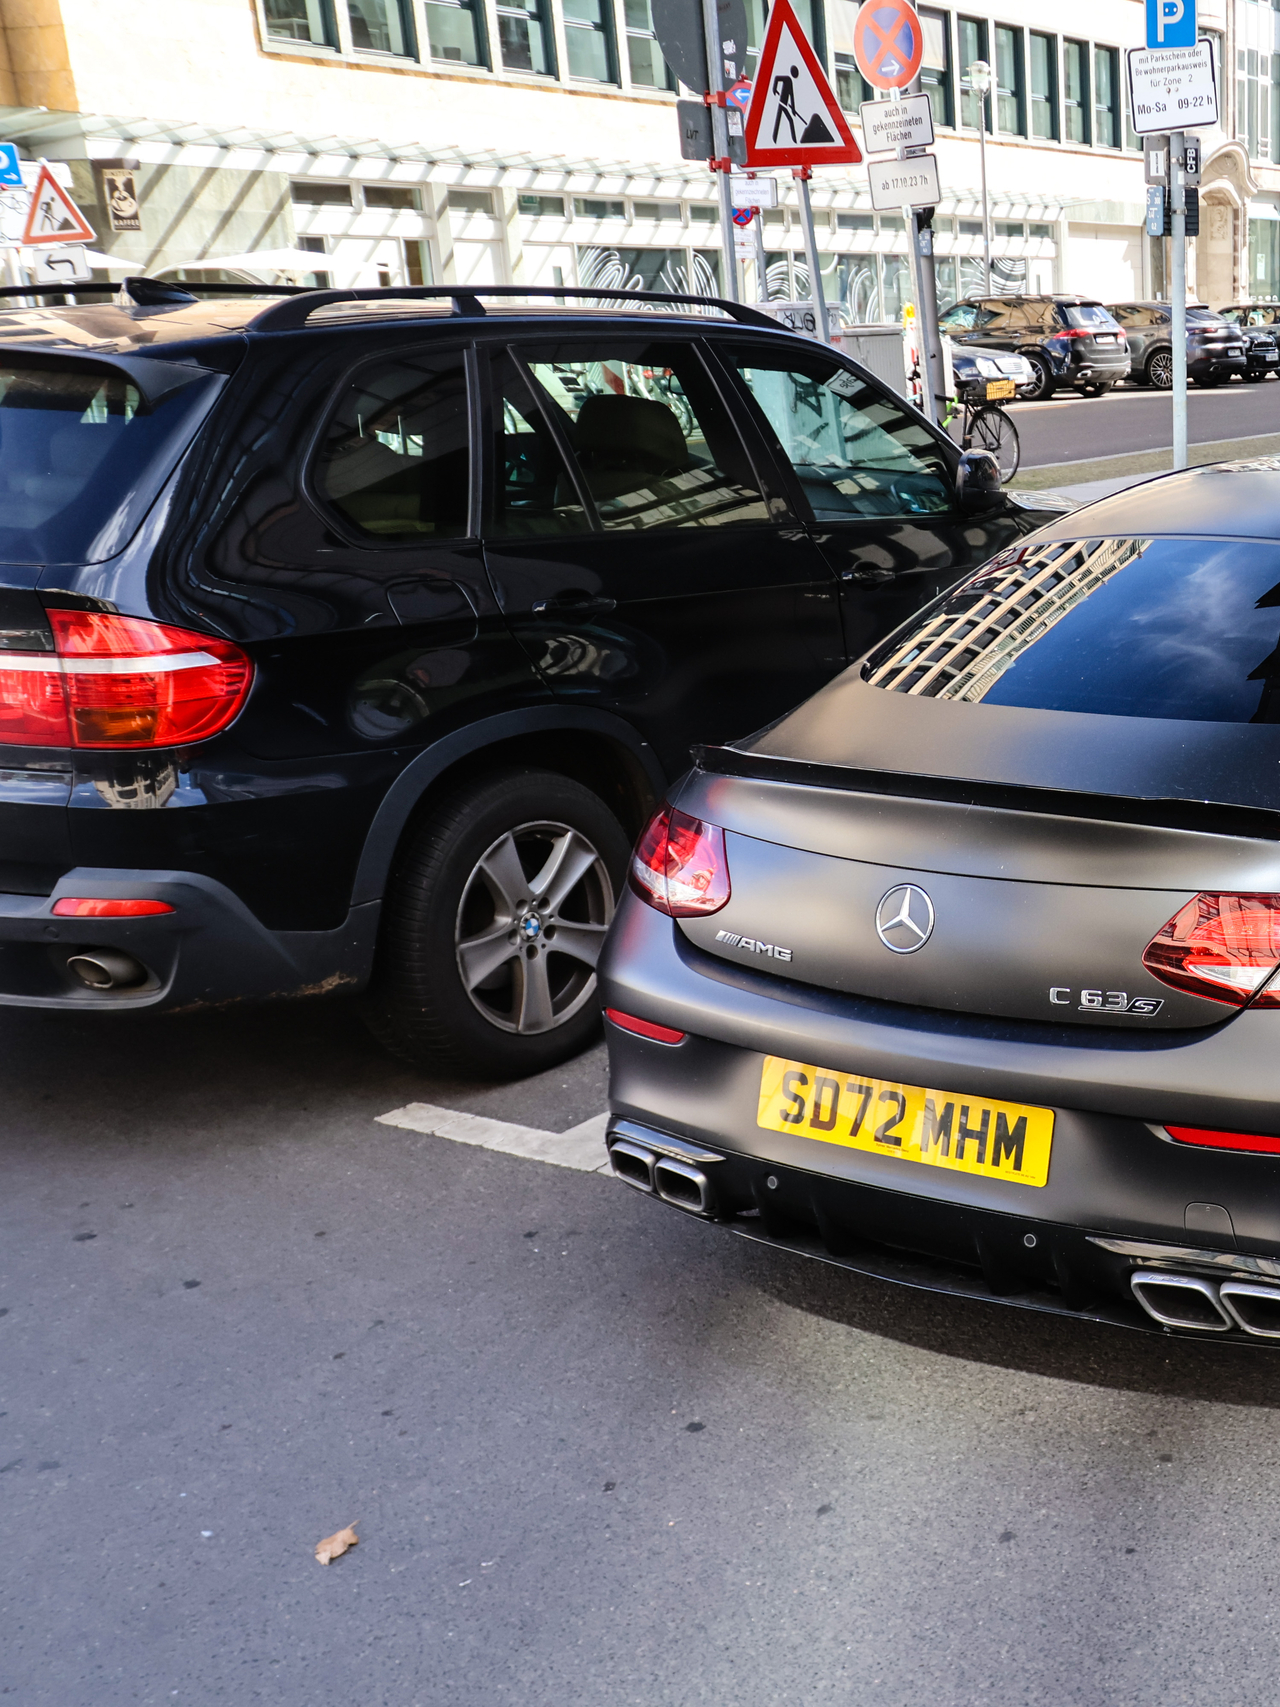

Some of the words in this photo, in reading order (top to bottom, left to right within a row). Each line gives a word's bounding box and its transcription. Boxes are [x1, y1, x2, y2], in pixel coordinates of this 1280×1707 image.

[1157, 0, 1184, 42] P
[1139, 55, 1149, 65] mit
[1150, 51, 1187, 63] Parkschein
[1188, 49, 1202, 58] oder
[1150, 79, 1161, 88] für
[1163, 76, 1182, 87] Zone
[1188, 74, 1193, 83] 2
[884, 106, 900, 118] auch
[901, 104, 908, 114] in
[1137, 102, 1167, 115] Mo-Sa
[1177, 96, 1204, 110] 09-22
[1207, 94, 1213, 105] h
[886, 130, 913, 143] Flächen
[1186, 148, 1196, 173] CFB
[881, 180, 890, 191] ab
[737, 937, 793, 962] AMG
[1049, 987, 1071, 1005] C
[779, 1070, 907, 1147] SD72
[919, 1097, 1028, 1172] MHM
